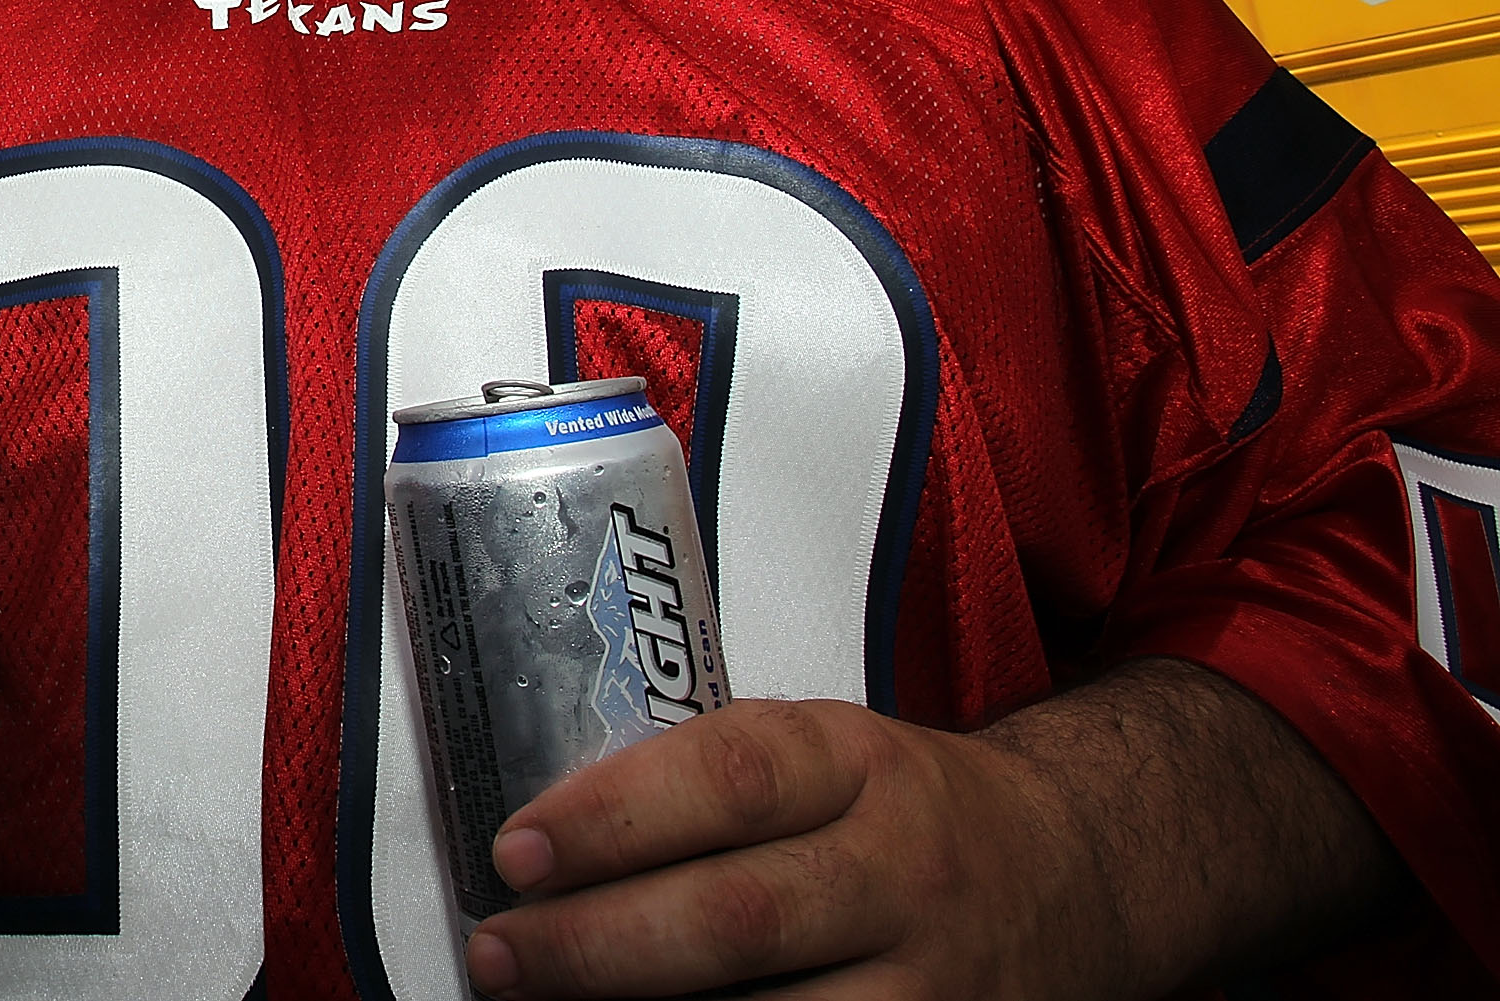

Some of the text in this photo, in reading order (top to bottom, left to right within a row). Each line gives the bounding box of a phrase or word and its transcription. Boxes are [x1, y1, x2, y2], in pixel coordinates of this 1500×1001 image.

[544, 413, 605, 437] Vented
[604, 409, 637, 427] Wide
[447, 529, 461, 562] FOOTBALL
[453, 563, 467, 596] NATIONAL
[459, 597, 470, 611] THE
[461, 611, 472, 622] OF
[609, 501, 704, 728] IGHT
[463, 623, 480, 669] TRADEMARKS
[698, 619, 715, 674] Can
[472, 670, 483, 684] ARE
